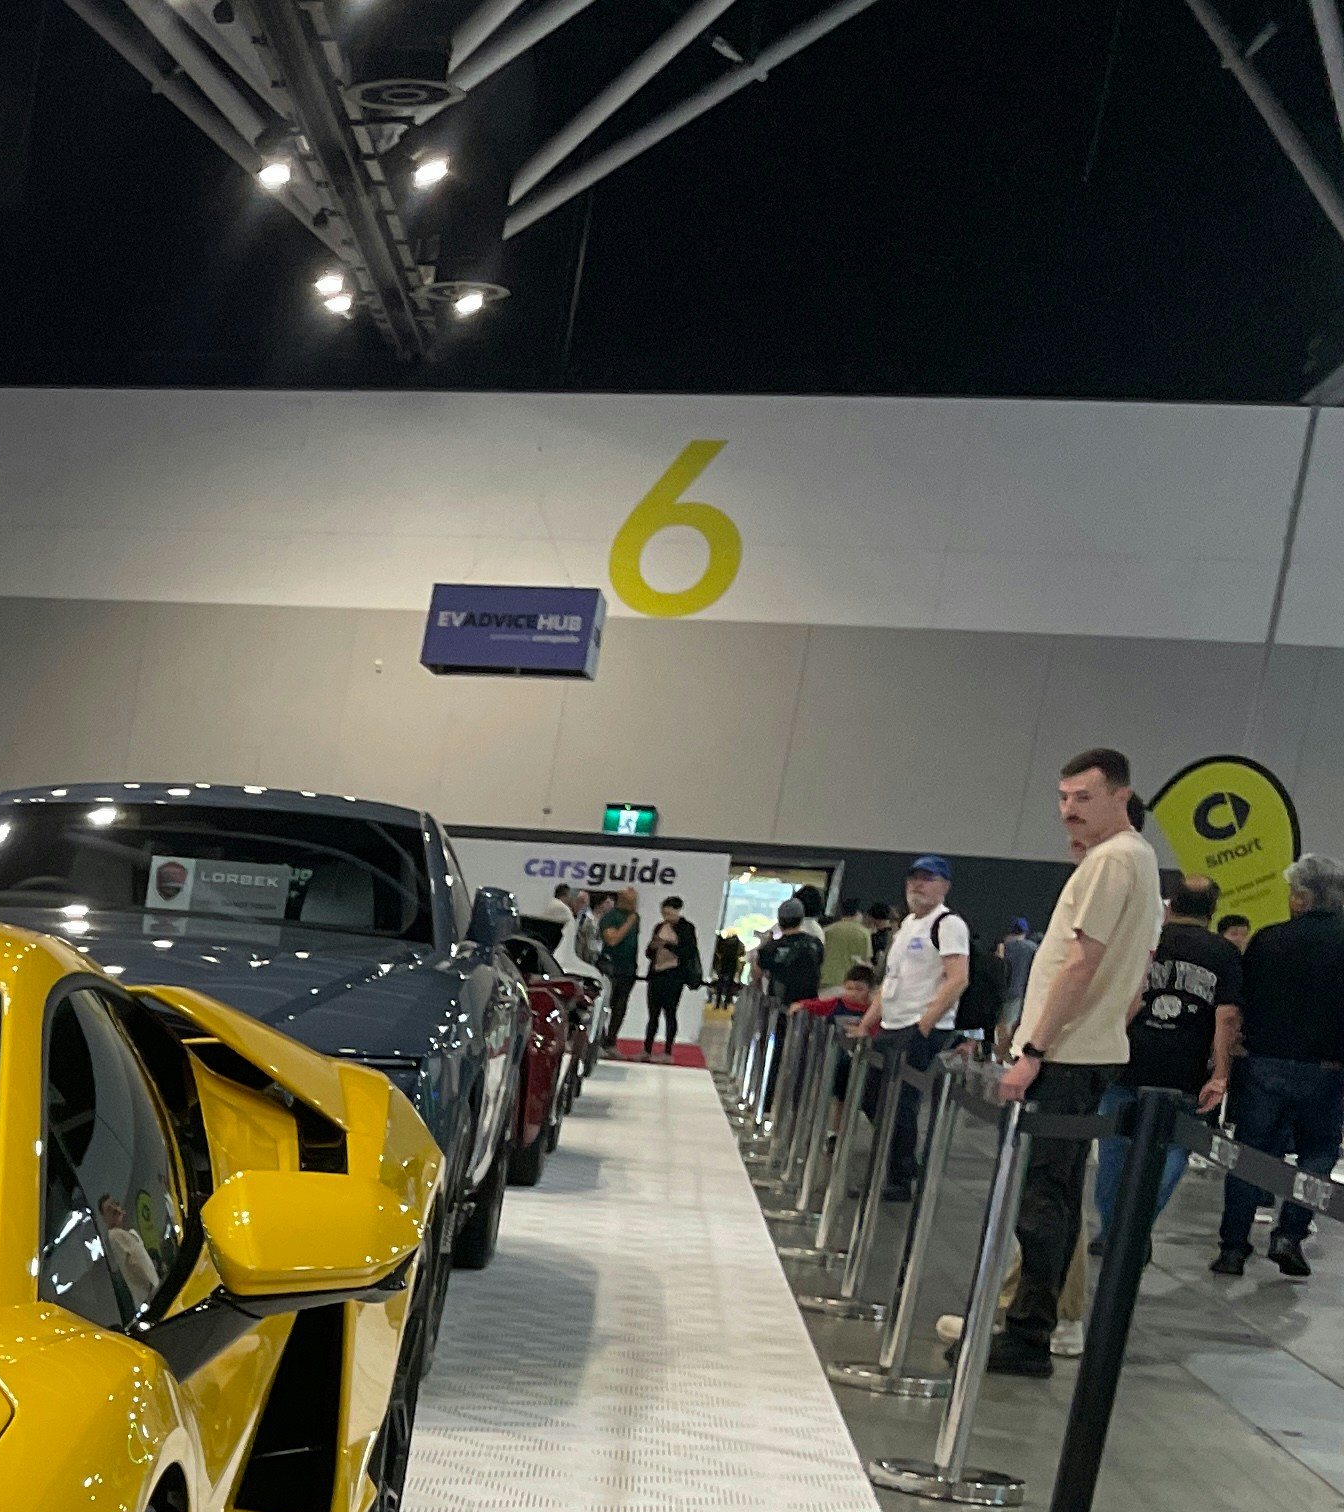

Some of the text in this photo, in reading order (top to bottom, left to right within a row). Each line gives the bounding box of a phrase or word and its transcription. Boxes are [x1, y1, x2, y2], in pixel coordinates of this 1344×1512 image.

[608, 438, 743, 619] 6
[1205, 837, 1263, 868] smart
[200, 871, 279, 888] LORBEK
[524, 857, 678, 885] carsguide
